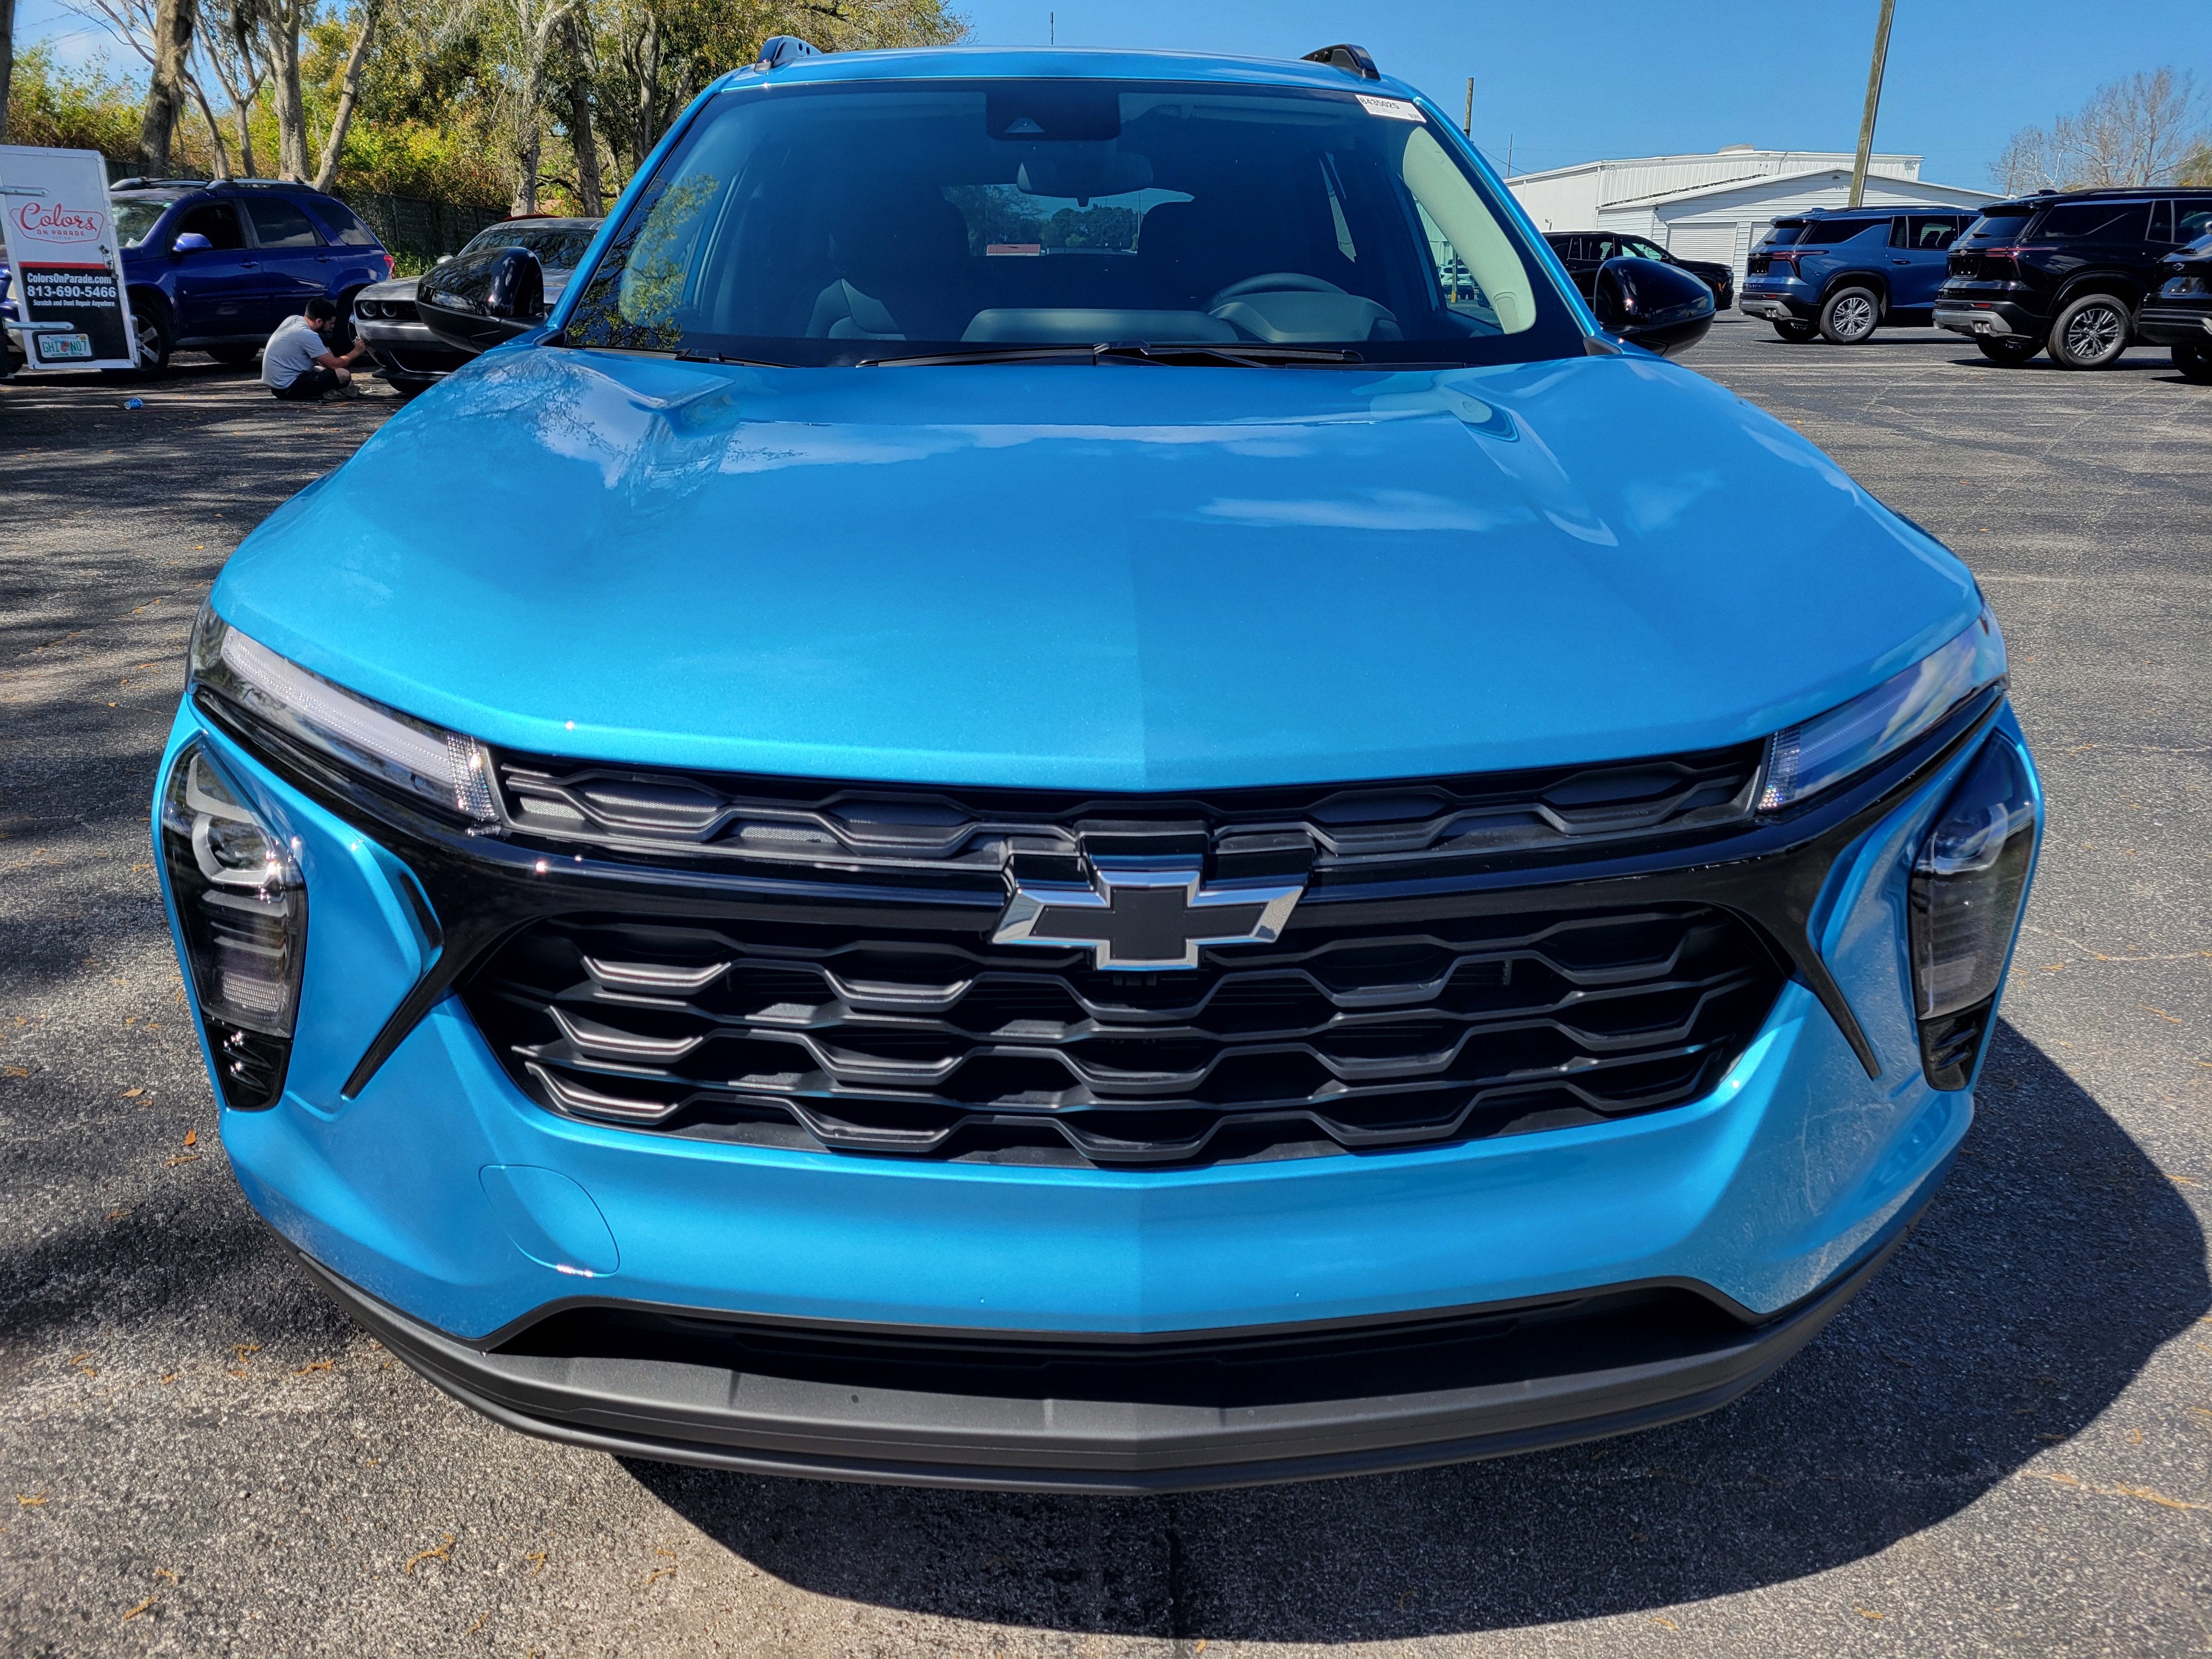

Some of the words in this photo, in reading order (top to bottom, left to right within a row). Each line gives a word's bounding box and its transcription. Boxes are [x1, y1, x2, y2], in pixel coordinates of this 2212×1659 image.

[20, 202, 97, 231] Colors
[27, 273, 111, 284] ColorsOnParade.com
[27, 285, 116, 298] 813-690-5466
